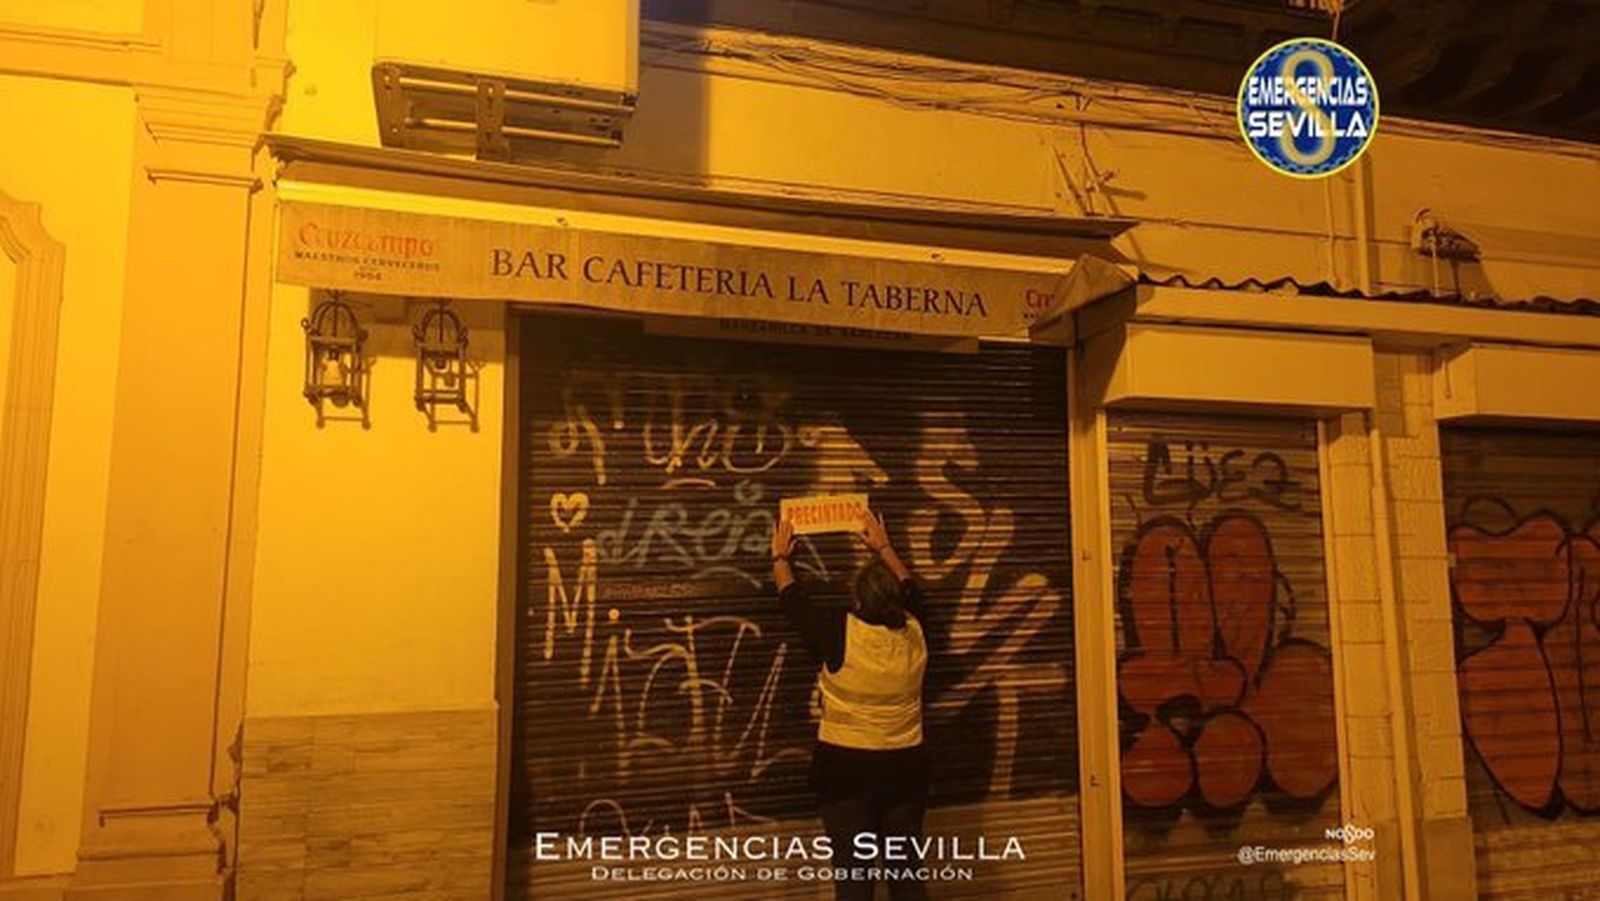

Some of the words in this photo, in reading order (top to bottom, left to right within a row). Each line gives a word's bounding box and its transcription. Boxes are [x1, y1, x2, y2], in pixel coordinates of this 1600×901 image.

[491, 248, 567, 280] BAR
[583, 257, 774, 298] CAFETERIA
[788, 275, 830, 305] LA
[841, 280, 989, 318] TABERNA
[787, 501, 866, 525] PRECINTADO
